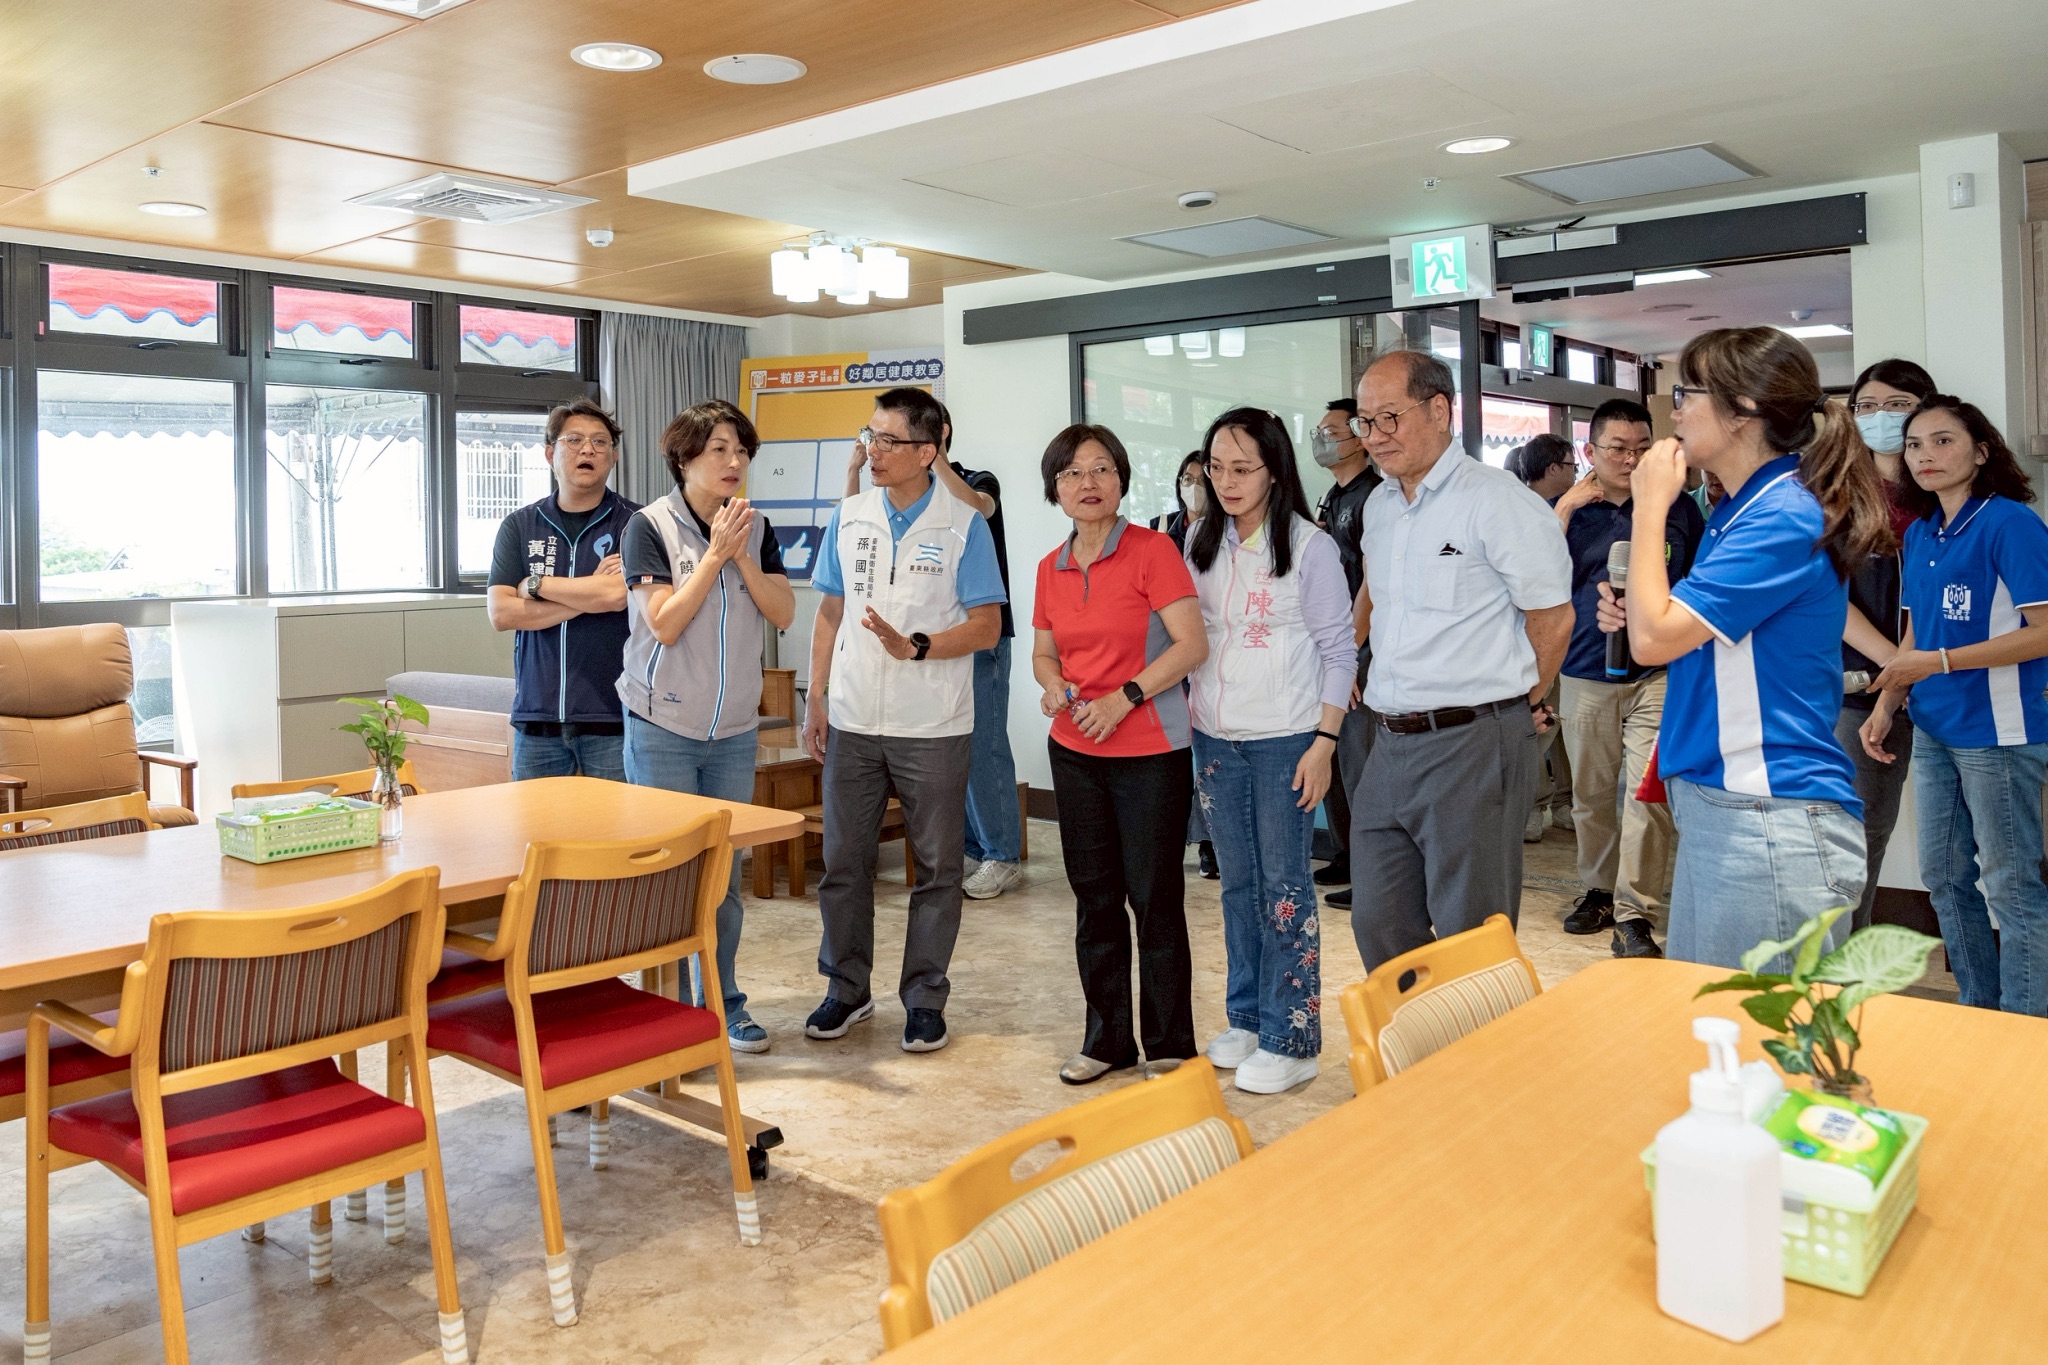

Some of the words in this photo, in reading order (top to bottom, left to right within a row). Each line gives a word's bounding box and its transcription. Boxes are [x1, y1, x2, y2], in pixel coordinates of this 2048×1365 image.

[767, 370, 819, 384] 一粒麥子
[848, 363, 941, 380] 好鄰居健康教室
[773, 468, 784, 476] A3
[545, 535, 558, 577] 立法委員
[853, 537, 870, 596] 孫國平
[866, 537, 878, 599] 臺東縣衛生局局長
[1243, 589, 1276, 649] 陳瑩
